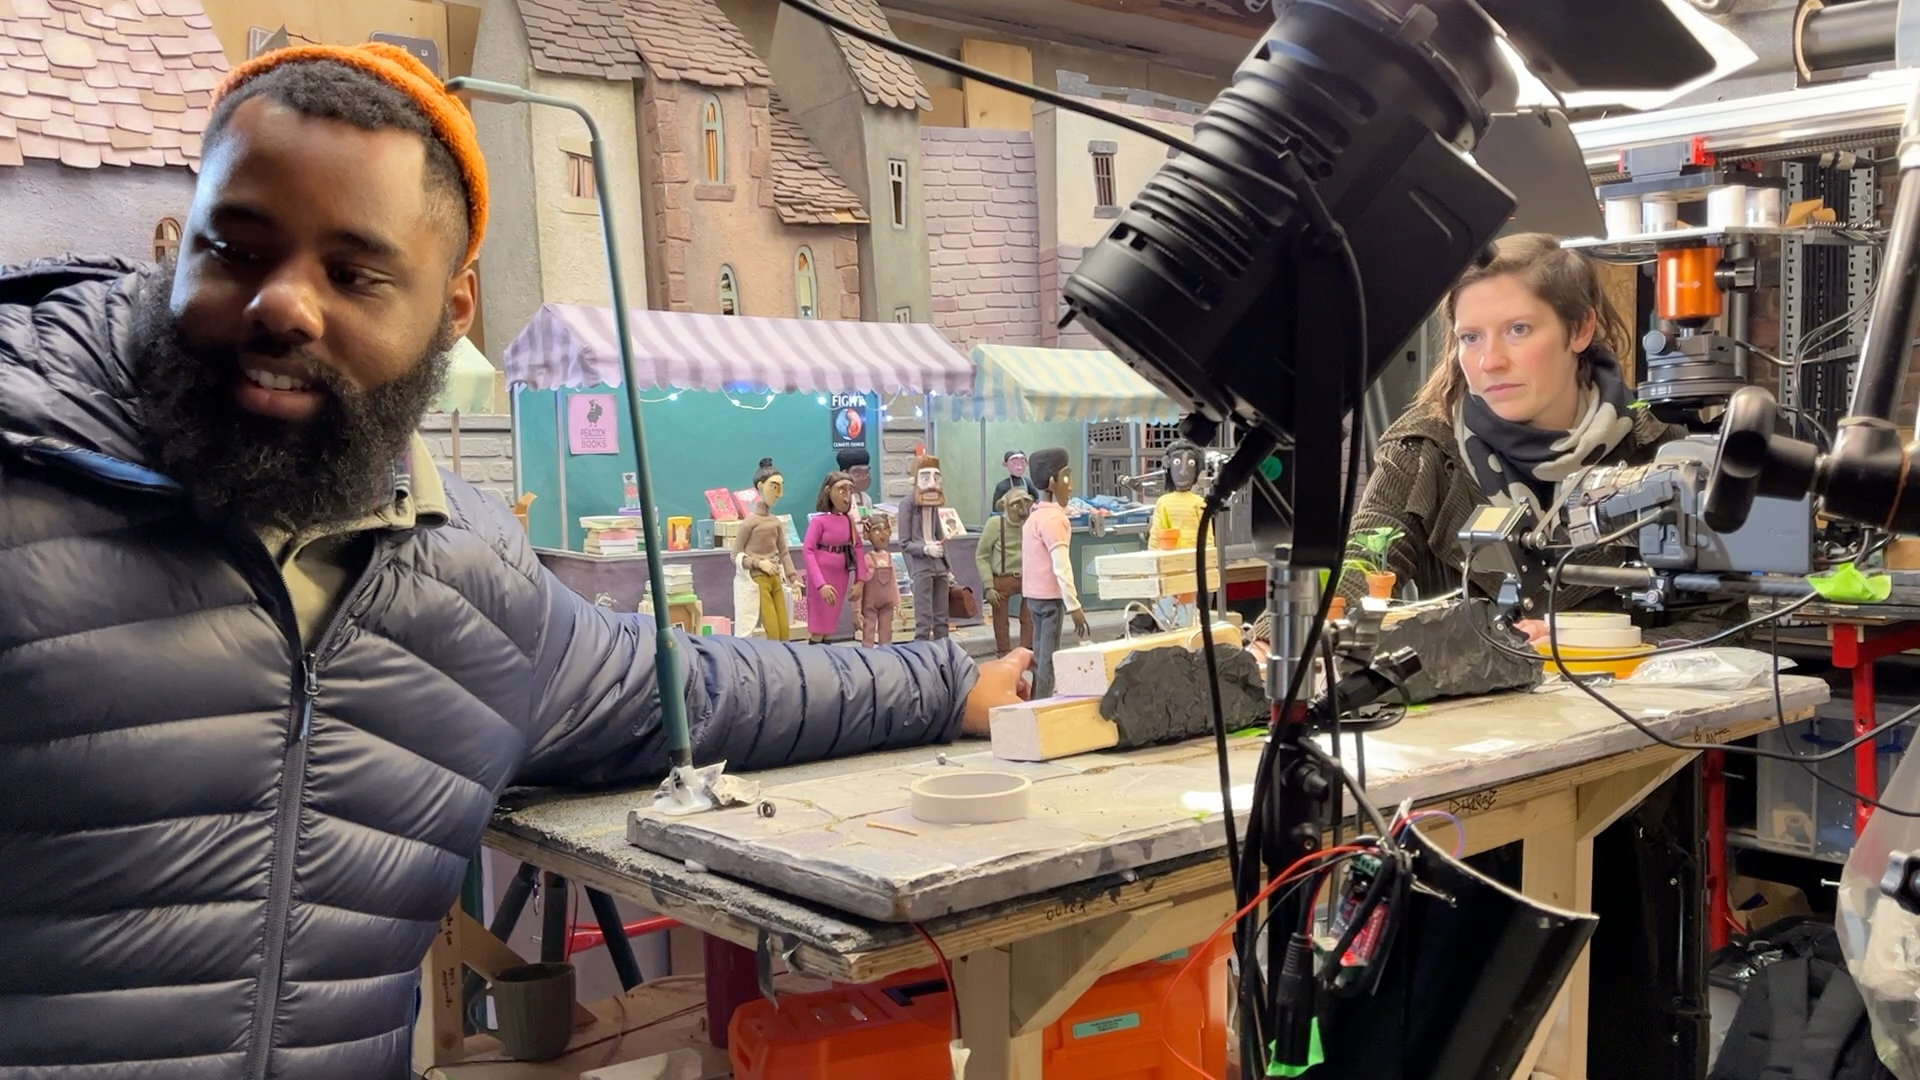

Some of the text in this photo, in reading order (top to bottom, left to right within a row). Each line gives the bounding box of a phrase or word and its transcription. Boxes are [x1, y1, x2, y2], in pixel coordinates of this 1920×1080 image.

[832, 395, 864, 407] FIGHT
[580, 428, 606, 437] PEACOCK
[580, 440, 607, 448] BOOKS
